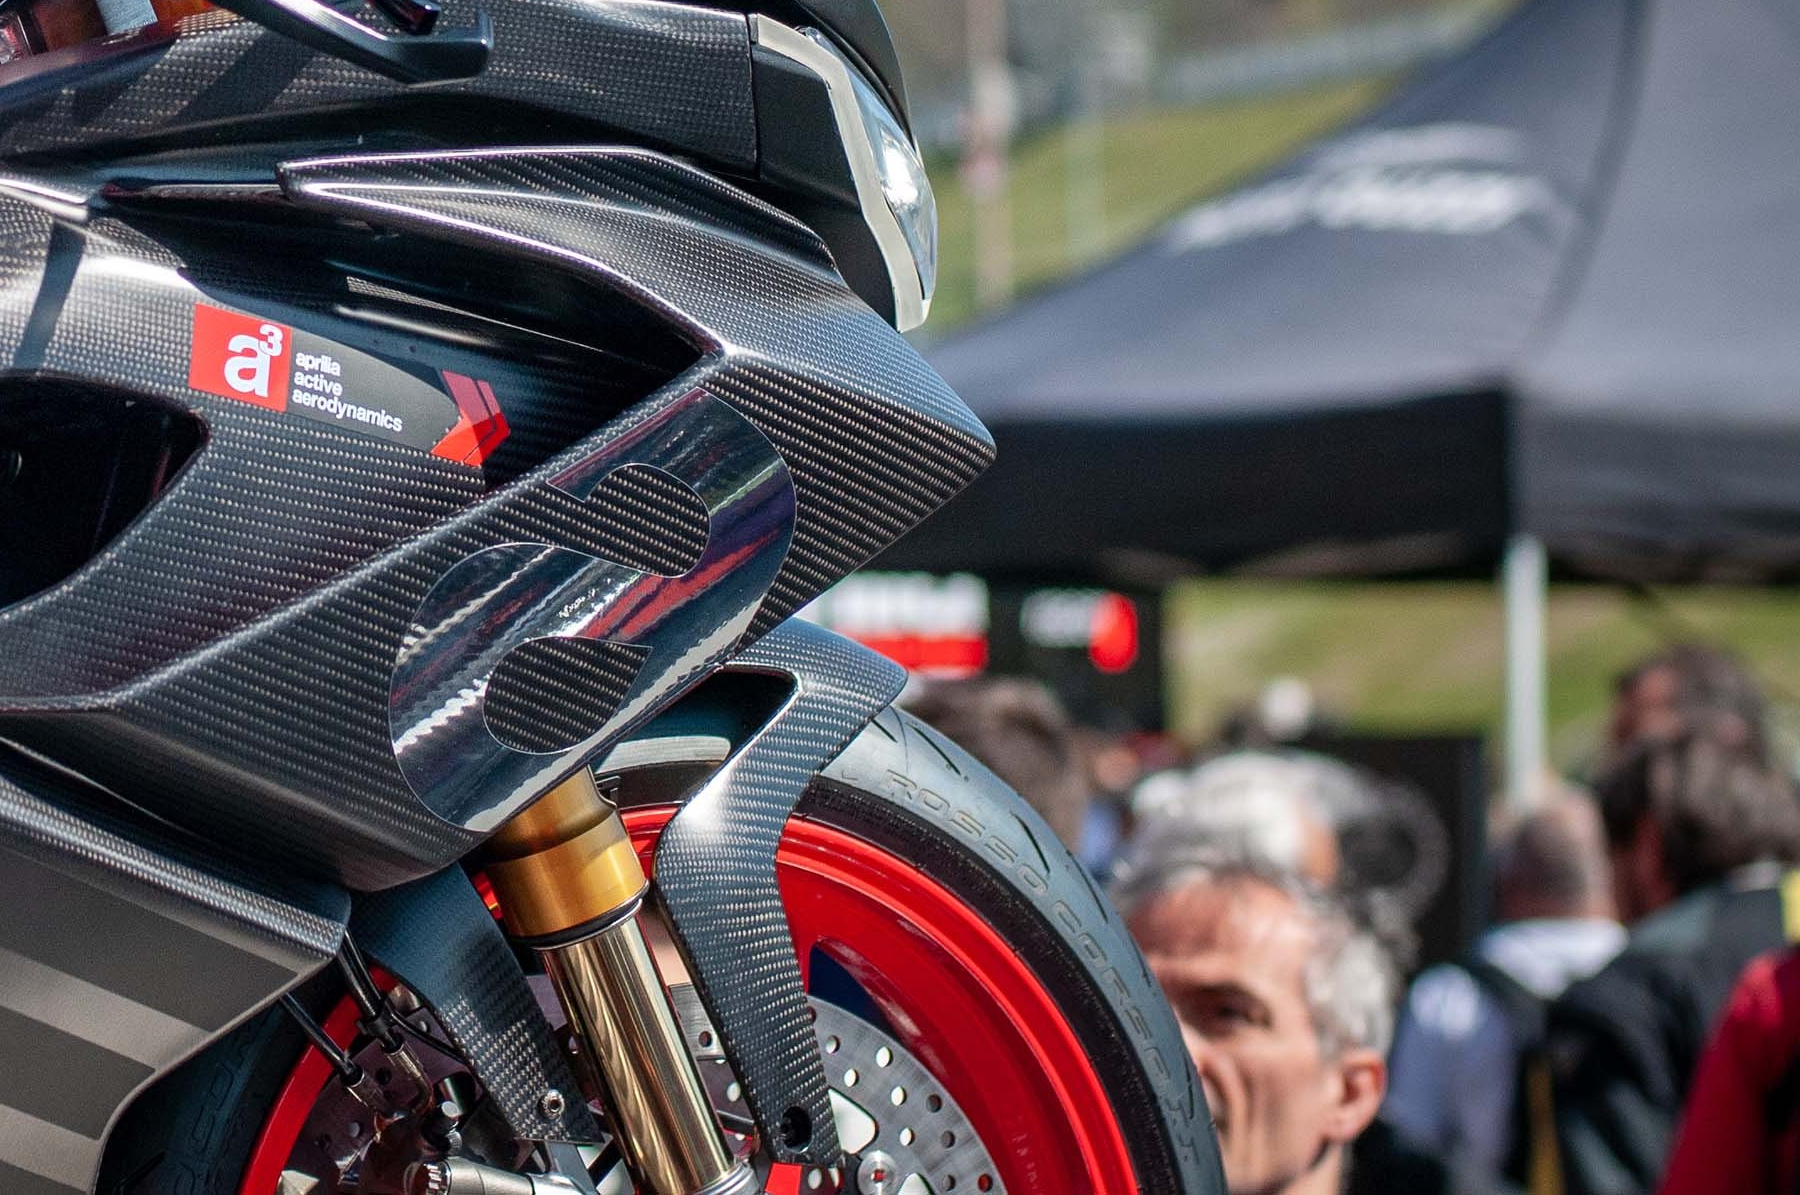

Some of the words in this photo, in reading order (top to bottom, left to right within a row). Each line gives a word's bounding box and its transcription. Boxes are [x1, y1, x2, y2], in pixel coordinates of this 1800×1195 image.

[295, 352, 341, 377] aprilia
[293, 371, 343, 396] active
[291, 389, 403, 432] aerodynamics
[886, 769, 1050, 896] ROSSO
